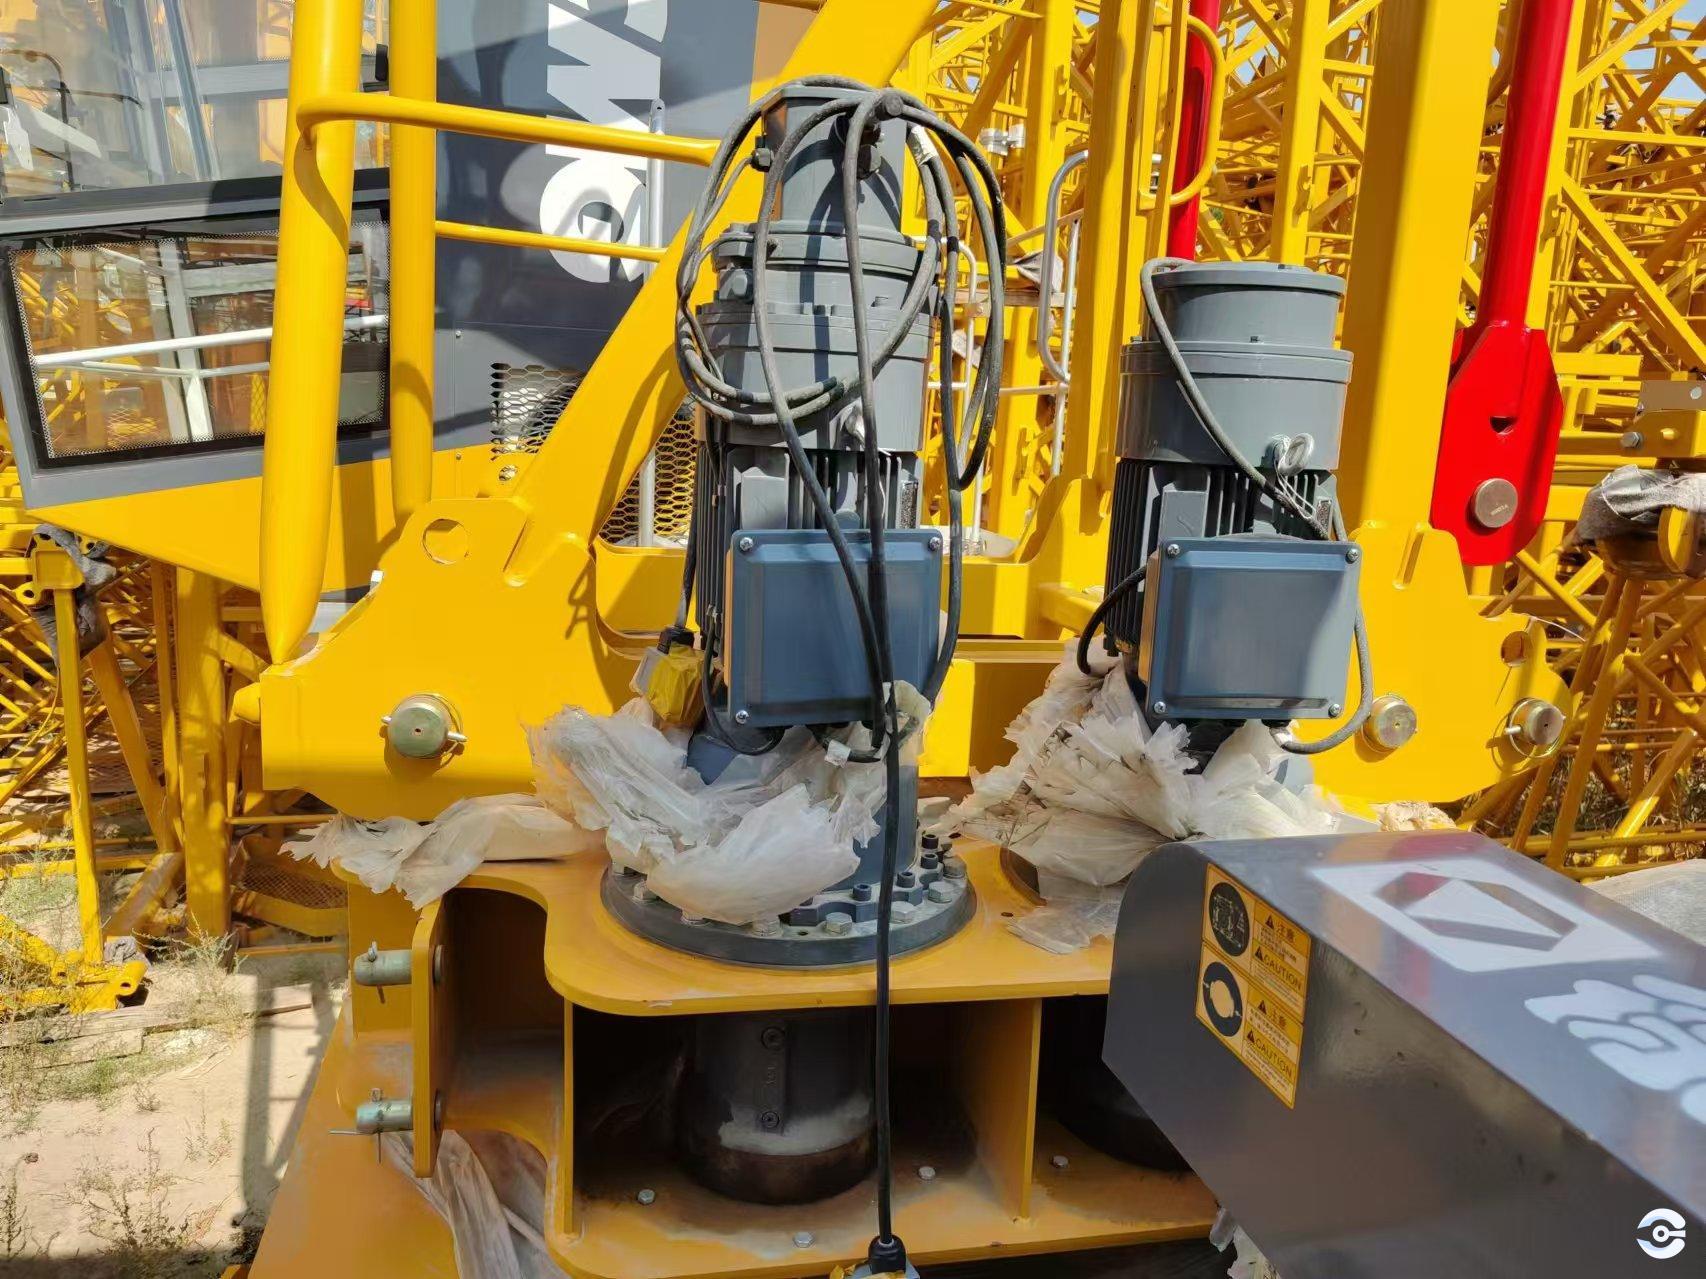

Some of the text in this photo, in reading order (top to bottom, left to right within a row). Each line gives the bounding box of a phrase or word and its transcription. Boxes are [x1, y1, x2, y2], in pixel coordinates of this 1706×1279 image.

[540, 0, 667, 283] MG
[1263, 955, 1302, 991] CAUTION
[1255, 1037, 1293, 1077] CAUTION
